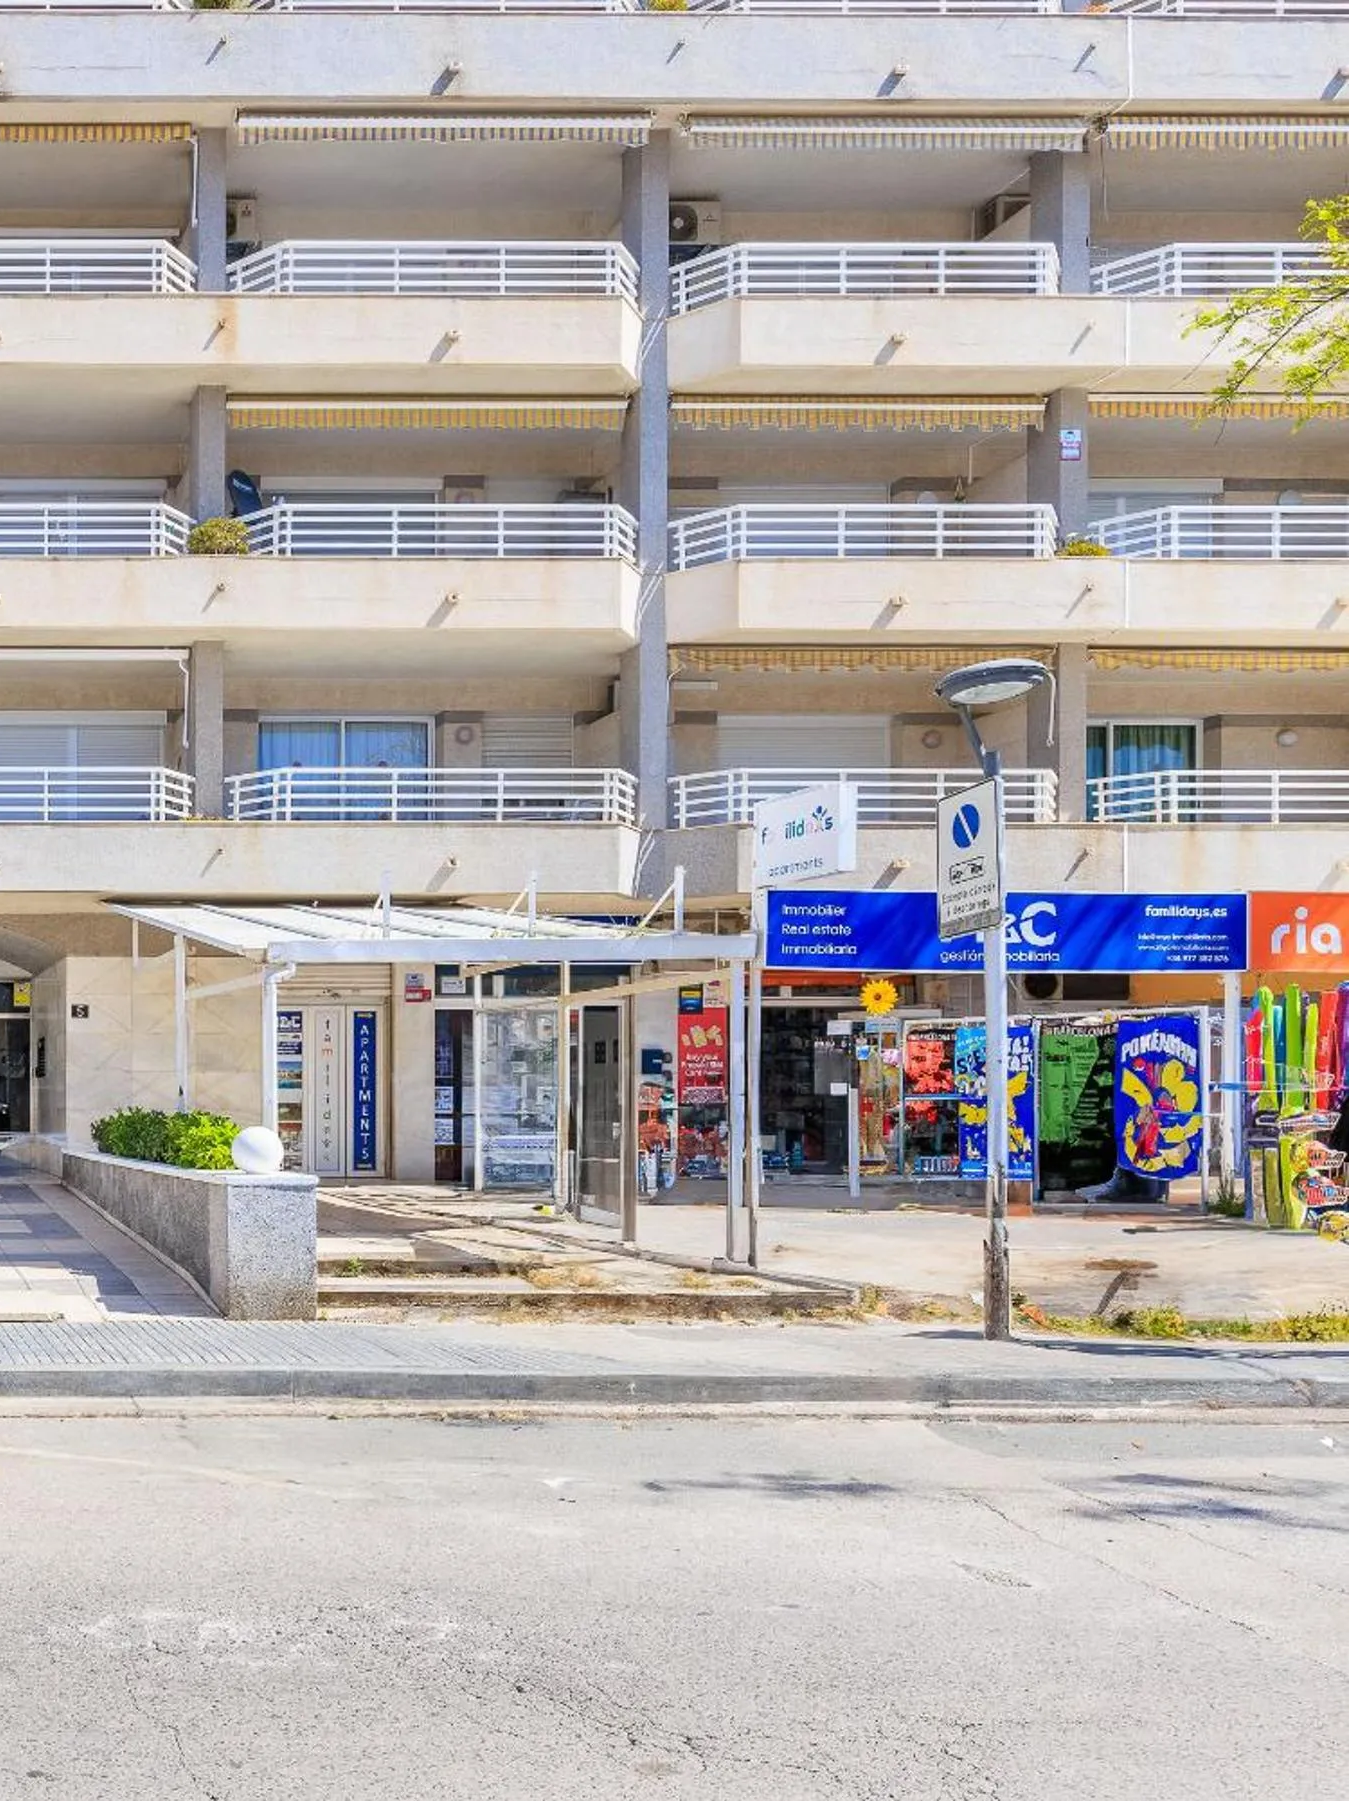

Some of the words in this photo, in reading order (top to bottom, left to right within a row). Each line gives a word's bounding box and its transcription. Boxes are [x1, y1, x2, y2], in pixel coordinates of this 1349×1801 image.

[781, 904, 848, 917] Immobilier
[1144, 904, 1228, 920] familidays.es
[781, 923, 810, 936] Real
[811, 923, 852, 936] estate
[1270, 905, 1343, 954] ria
[358, 1024, 371, 1160] APARTMENTS
